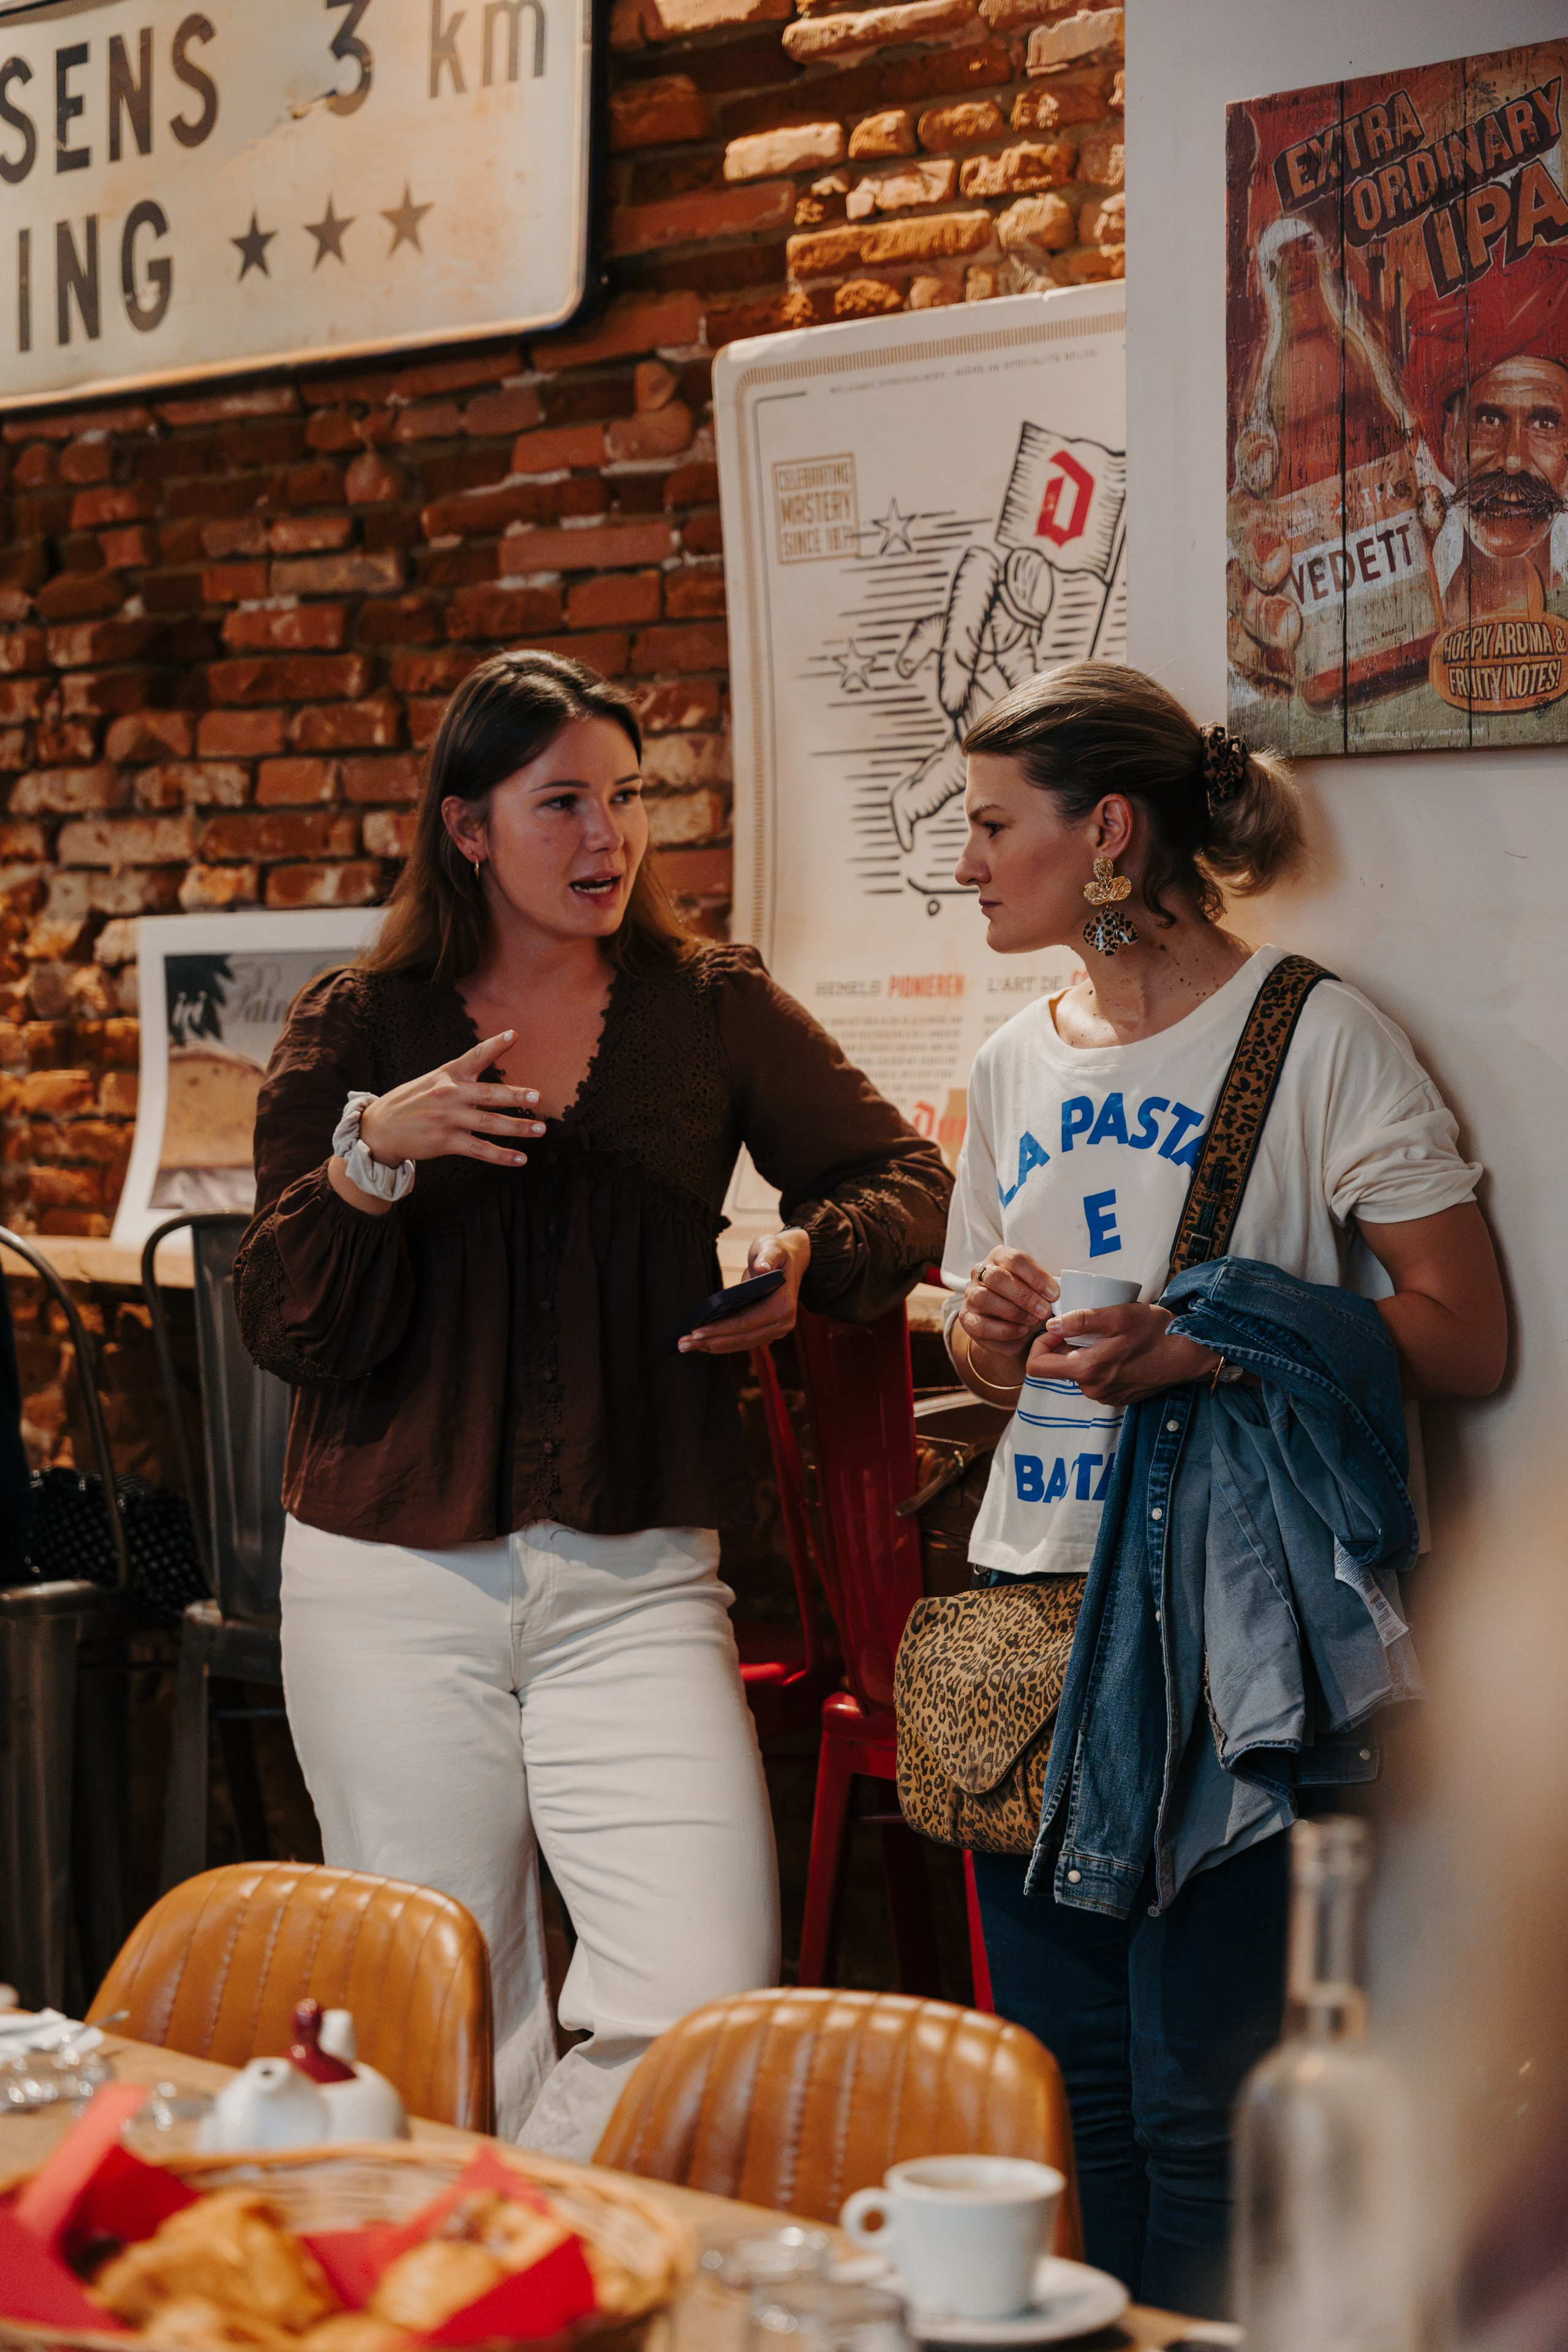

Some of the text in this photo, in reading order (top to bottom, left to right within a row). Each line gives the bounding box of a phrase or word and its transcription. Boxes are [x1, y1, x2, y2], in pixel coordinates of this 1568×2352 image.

[0, 0, 546, 184] SENS 3 km
[1279, 90, 1425, 205] EXTRA
[1349, 78, 1561, 238] ORDINARY
[1427, 159, 1568, 288] IPA
[18, 200, 173, 353] ING
[1289, 524, 1412, 605] VEDETT
[1444, 622, 1567, 663] HOPPY AROMA &
[1449, 660, 1562, 702] FRUITY NOTES!
[1061, 1092, 1205, 1171] PASTA
[1084, 1189, 1121, 1258] E
